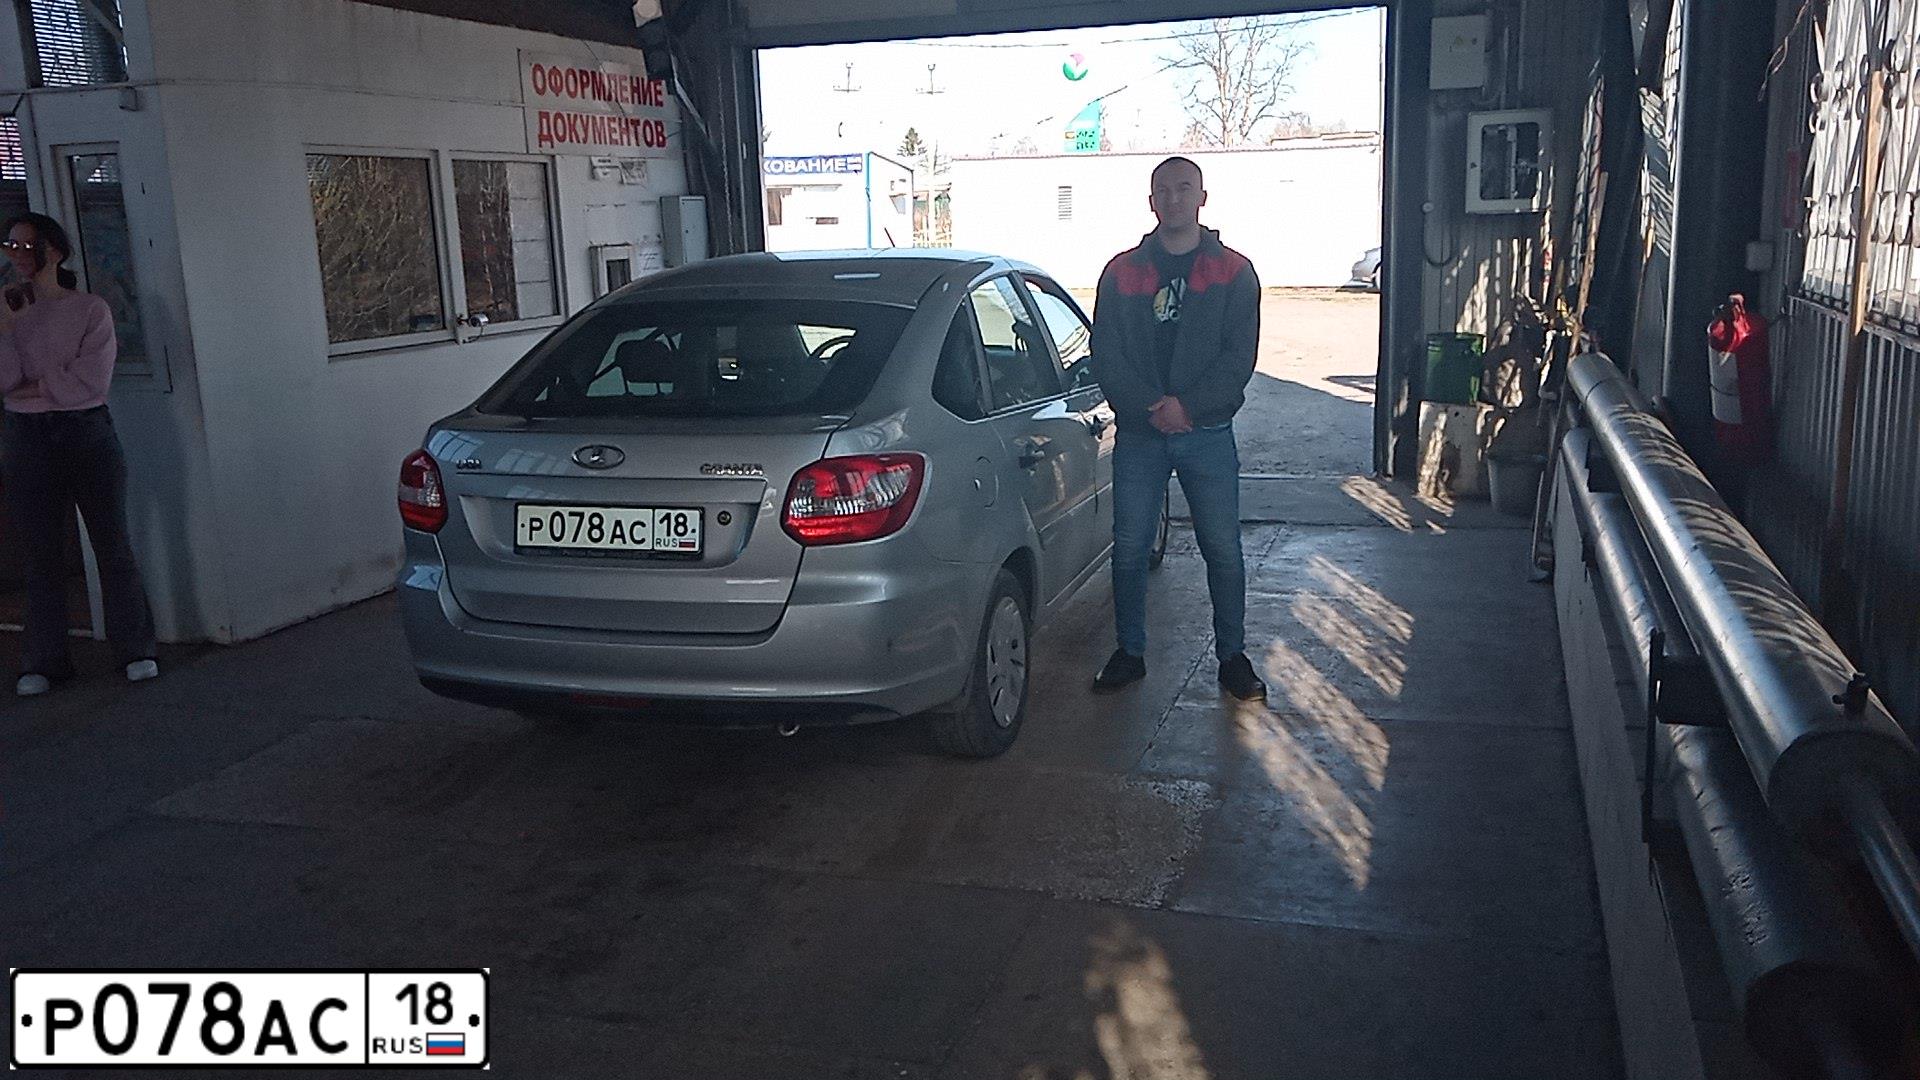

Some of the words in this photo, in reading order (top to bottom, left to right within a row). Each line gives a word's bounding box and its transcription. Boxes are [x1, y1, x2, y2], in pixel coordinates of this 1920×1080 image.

[531, 63, 665, 108] ОФОРМЛЕНИЕ
[537, 110, 667, 149] ДОКУМЕНТОВ
[658, 512, 689, 537] 18
[655, 537, 678, 548] RUS
